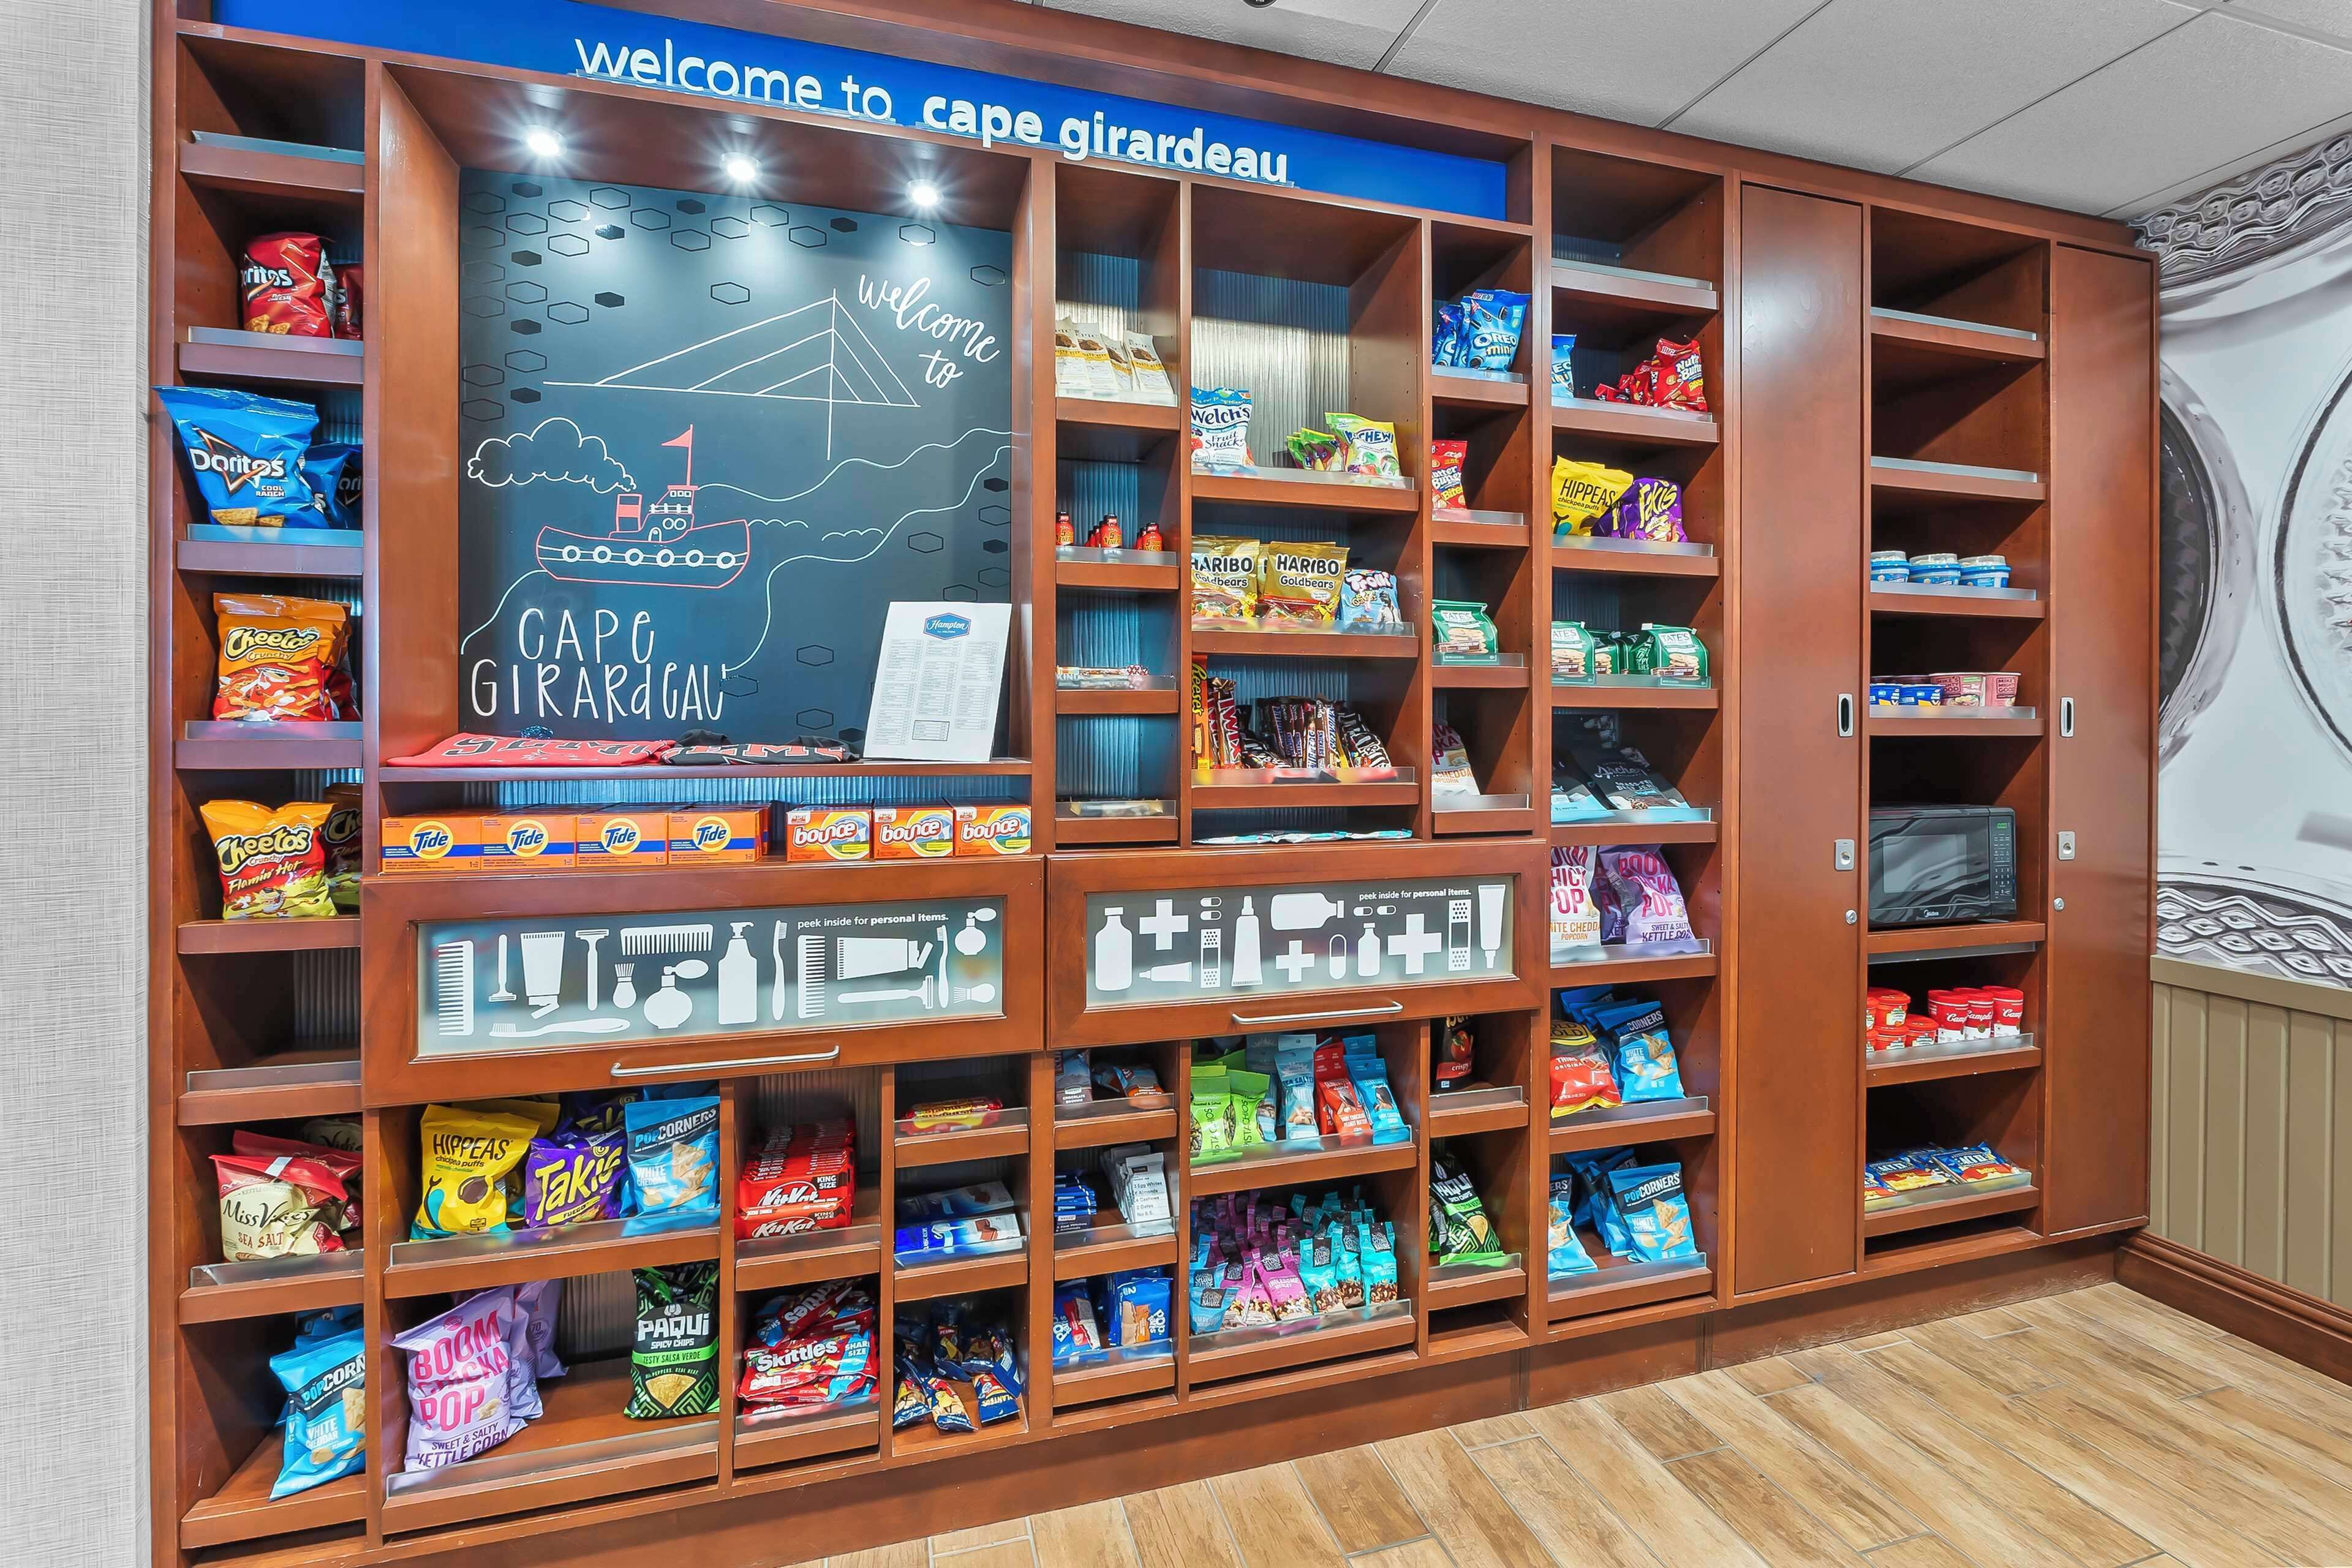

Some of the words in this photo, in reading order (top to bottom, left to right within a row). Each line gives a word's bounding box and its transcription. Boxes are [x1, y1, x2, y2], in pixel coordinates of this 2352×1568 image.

[575, 38, 823, 109] welcome
[841, 74, 892, 120] to
[923, 95, 1042, 148] cape
[1058, 111, 1287, 183] girardeau
[859, 274, 1000, 363] welcome
[1474, 333, 1517, 348] OREO
[1486, 344, 1512, 355] mini
[918, 349, 963, 388] to
[1191, 407, 1250, 424] Welch's
[1205, 438, 1245, 449] Snacks
[1212, 431, 1237, 442] Fruit
[189, 448, 285, 478] Doritos
[1560, 478, 1616, 510] HIPPEAS
[1558, 497, 1584, 508] chickpea
[1585, 503, 1600, 512] puffs
[1277, 554, 1340, 575] HARIBO
[1195, 573, 1248, 587] Goldbears
[1280, 576, 1334, 589] Goldbears
[927, 619, 969, 631] Hampton
[224, 627, 319, 661] Cheetos
[1662, 632, 1690, 643] TATE'S
[246, 650, 293, 661] Crunchy
[1191, 663, 1208, 717] Reese's
[1436, 768, 1473, 778] CHEDDA
[604, 827, 637, 850] Tide
[696, 824, 728, 846] Tide
[793, 821, 858, 846] bounce
[880, 820, 942, 845] bounce
[962, 818, 1020, 842] bounce
[413, 830, 449, 853] Tide
[510, 829, 545, 851] Tide
[216, 827, 312, 876] Cheetos
[247, 854, 284, 865] Crunchy
[228, 867, 274, 895] Flamin'
[275, 860, 302, 878] Hot
[1359, 892, 1378, 902] peek
[1378, 891, 1400, 899] inside
[1401, 890, 1412, 899] for
[1412, 888, 1447, 899] personal
[1447, 888, 1472, 897] items.
[797, 918, 821, 930] peek
[823, 916, 852, 927] inside
[854, 915, 869, 925] for
[870, 913, 915, 926] personal
[918, 911, 949, 922] items.
[1571, 922, 1600, 932] CHEDD
[1642, 930, 1673, 942] KETTLE
[1624, 1047, 1644, 1059] WHITE
[1451, 1063, 1469, 1072] crispy
[634, 1108, 717, 1147] POPCORNERS
[432, 1133, 511, 1161] HIPPEAS
[1961, 1156, 1975, 1165] ACT
[636, 1166, 666, 1177] WHITE
[535, 1145, 623, 1221] Takis
[636, 1176, 666, 1187] CHEDDAR
[1623, 1173, 1681, 1203] POPCORNERS
[223, 1199, 259, 1227] Miss
[562, 1204, 587, 1219] FUEGO
[753, 1219, 816, 1238] KitKat
[1631, 1216, 1654, 1227] WHITE
[238, 1232, 254, 1248] SEA
[257, 1232, 284, 1248] SALT
[530, 1322, 542, 1333] 70
[414, 1309, 503, 1381] BOOM
[650, 1340, 673, 1349] SPICY
[673, 1338, 695, 1348] CHIPS
[848, 1347, 867, 1357] SIZE
[643, 1355, 660, 1365] ZESTY
[661, 1353, 680, 1363] SALSA
[682, 1351, 701, 1361] VERDE
[756, 1339, 840, 1373] Skittles
[301, 1354, 366, 1406] POPCORN
[419, 1384, 486, 1431] POP
[431, 1438, 461, 1450] SWEET
[462, 1433, 470, 1445] &
[472, 1421, 499, 1441] SALTY
[417, 1444, 470, 1468] KETTLE
[472, 1427, 509, 1453] CORN
